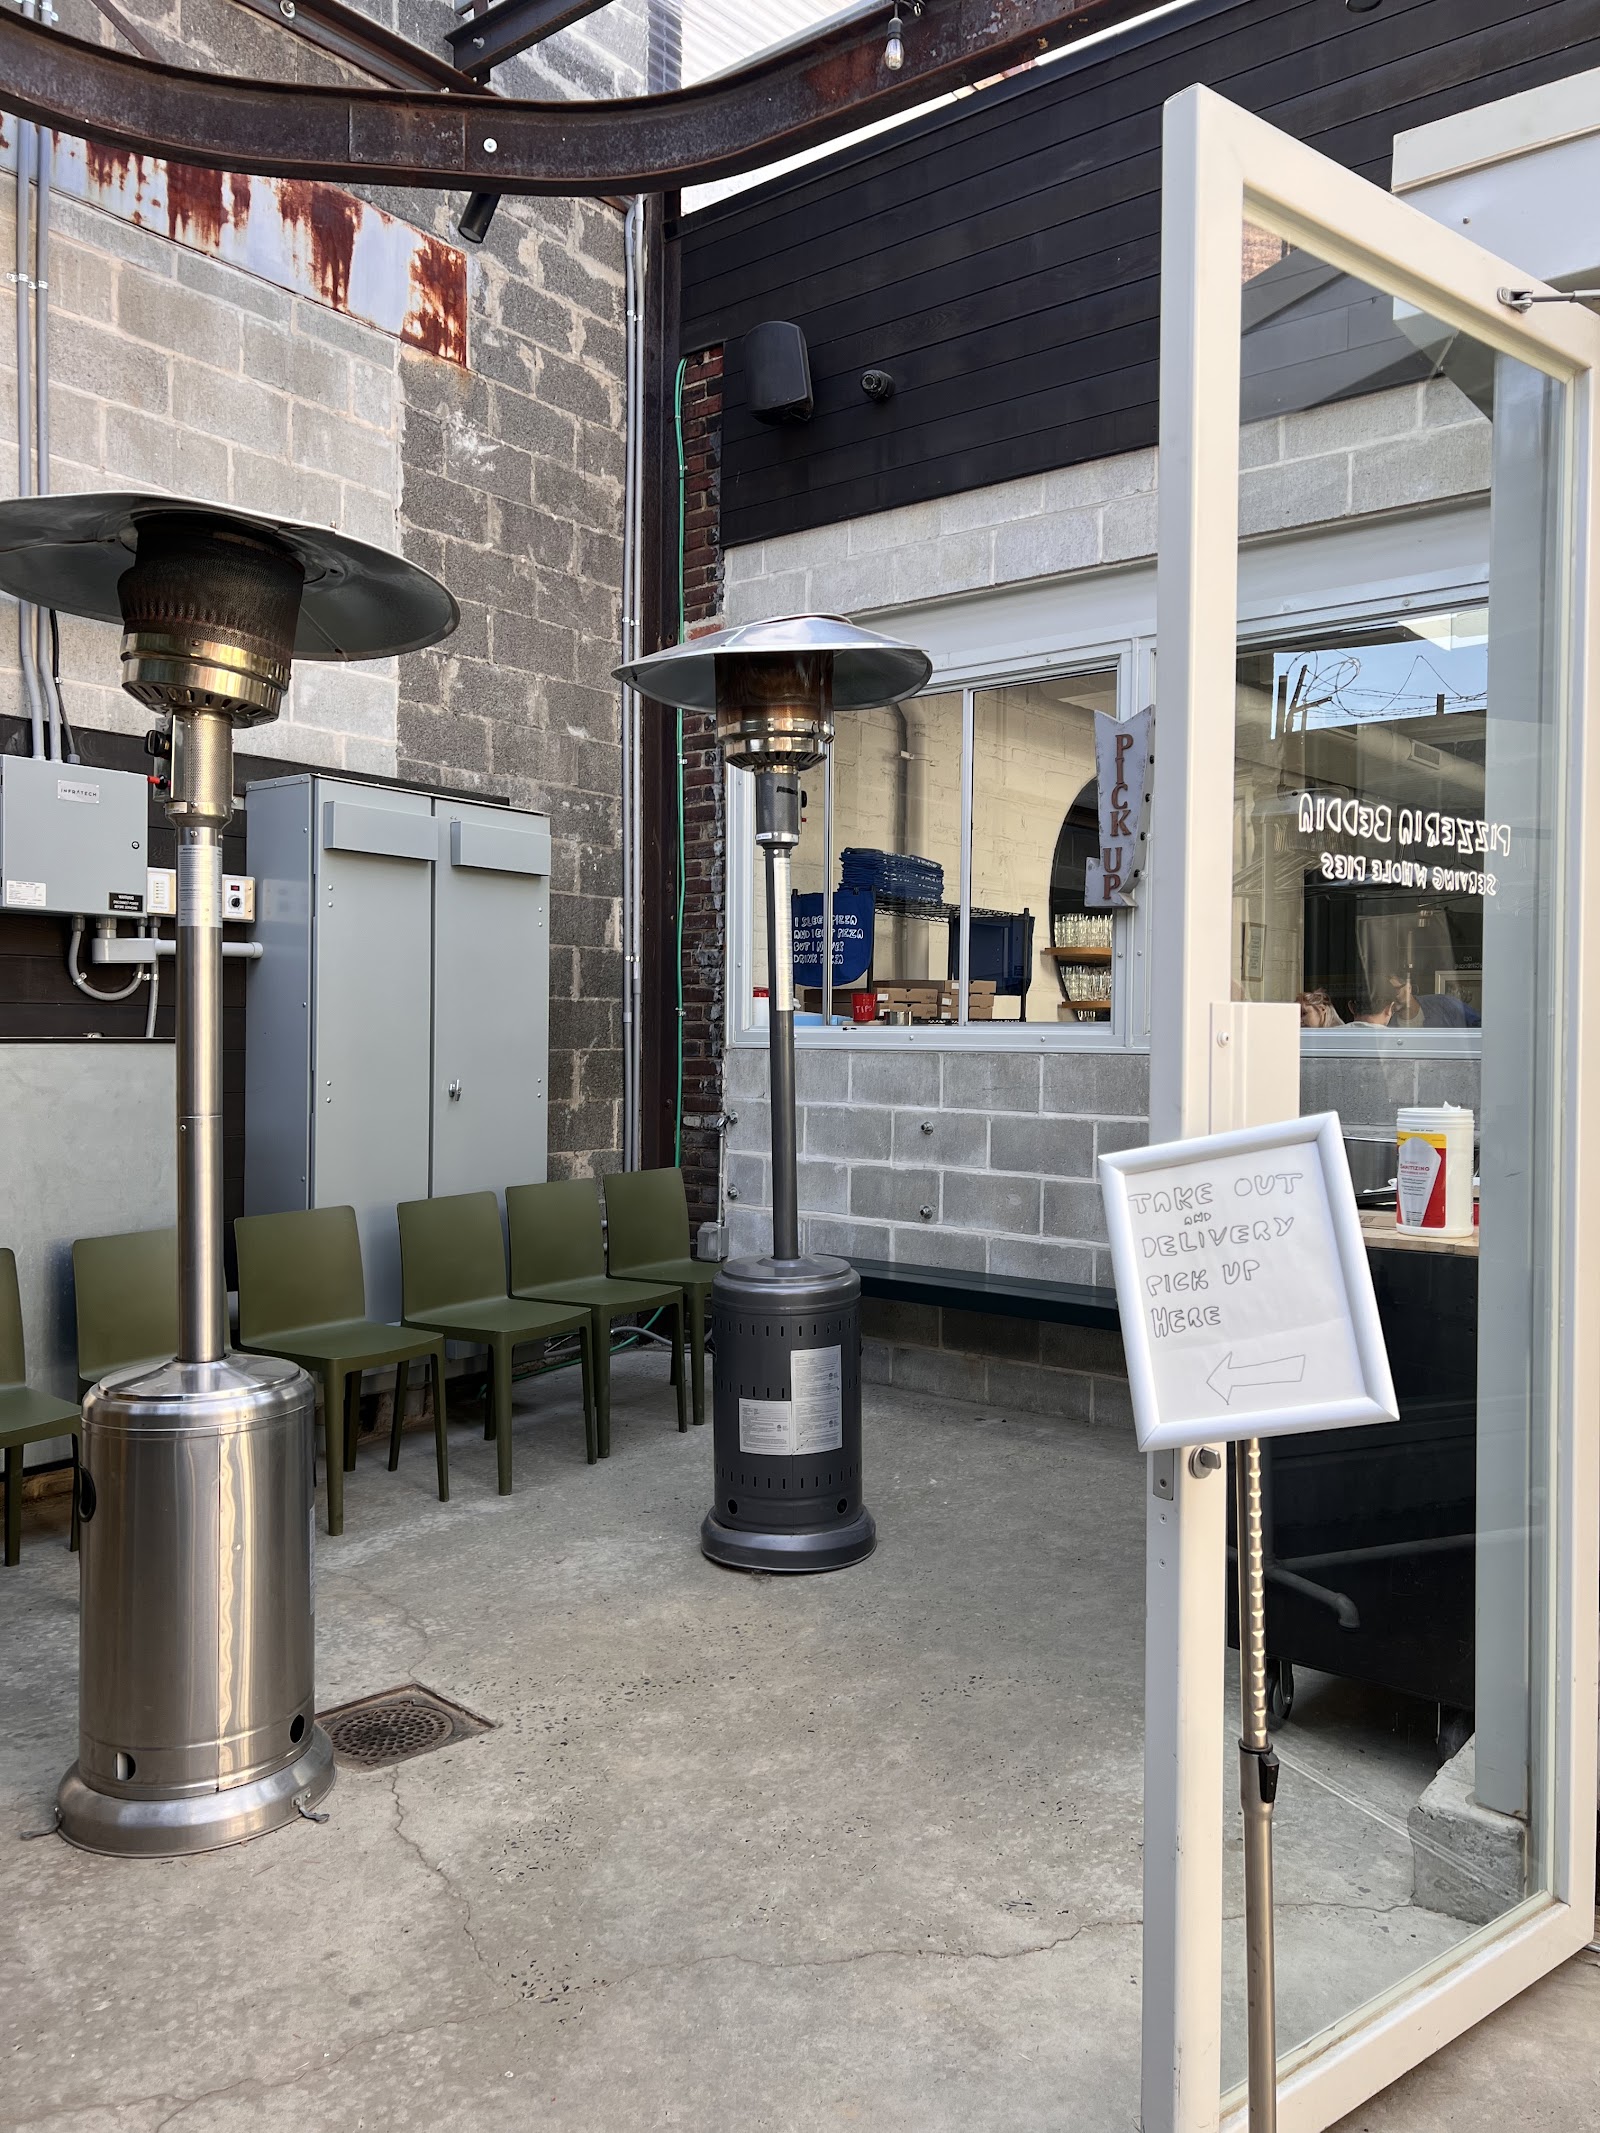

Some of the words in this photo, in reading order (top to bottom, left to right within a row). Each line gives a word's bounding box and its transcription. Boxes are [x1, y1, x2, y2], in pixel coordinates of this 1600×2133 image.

[60, 788, 97, 797] INFRATECH
[1111, 733, 1134, 837] PICK
[1102, 846, 1123, 900] UP
[801, 915, 824, 928] SLEE
[793, 941, 811, 952] BUT
[855, 1004, 873, 1014] TIPS
[1128, 1182, 1213, 1214] TAKE
[1234, 1173, 1303, 1197] OUT
[1184, 1212, 1212, 1225] AND
[1142, 1217, 1294, 1258] DELIVERY
[1146, 1269, 1209, 1297] PICK
[1222, 1259, 1260, 1285] UP
[1151, 1306, 1222, 1338] HERE
